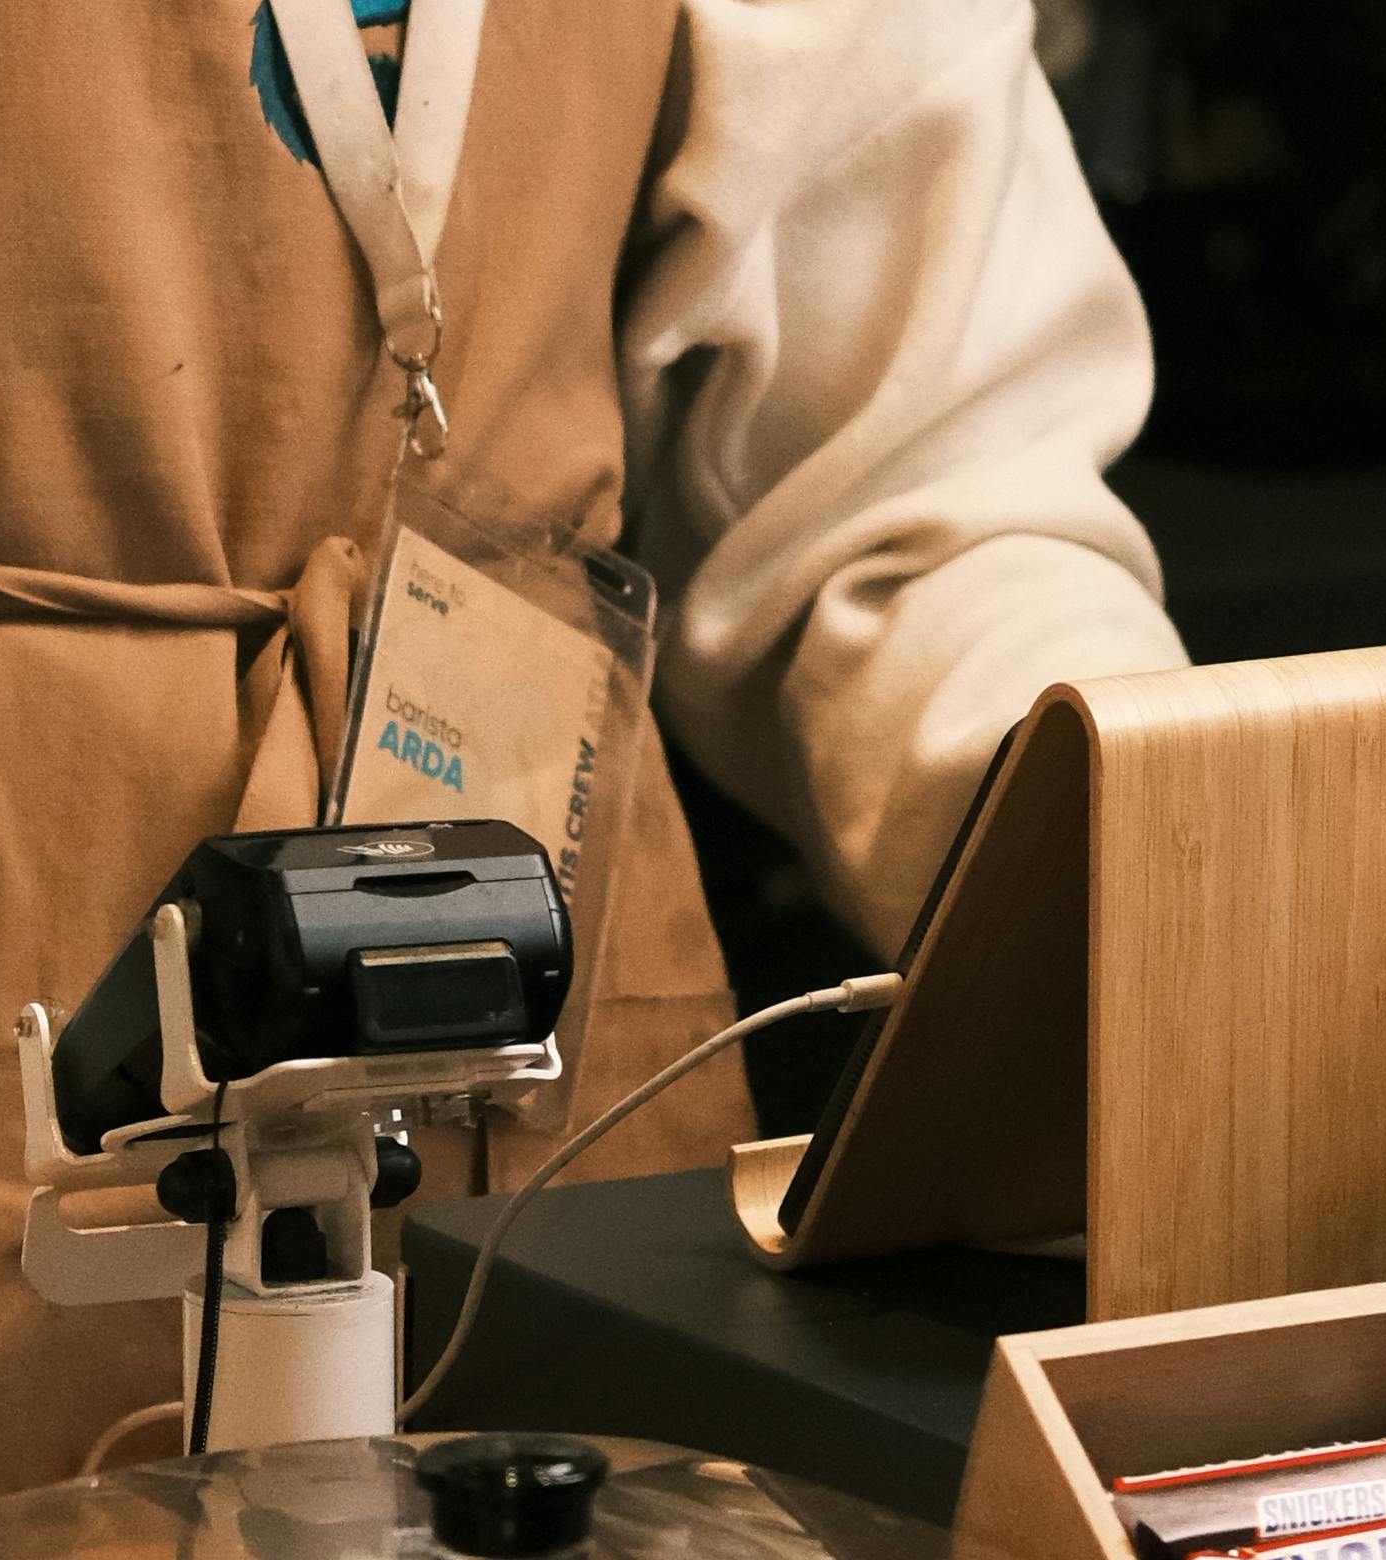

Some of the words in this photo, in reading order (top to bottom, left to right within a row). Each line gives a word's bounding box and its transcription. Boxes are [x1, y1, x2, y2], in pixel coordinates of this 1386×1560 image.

[386, 684, 463, 749] barista
[377, 720, 463, 794] ARDA
[566, 735, 597, 842] CREW
